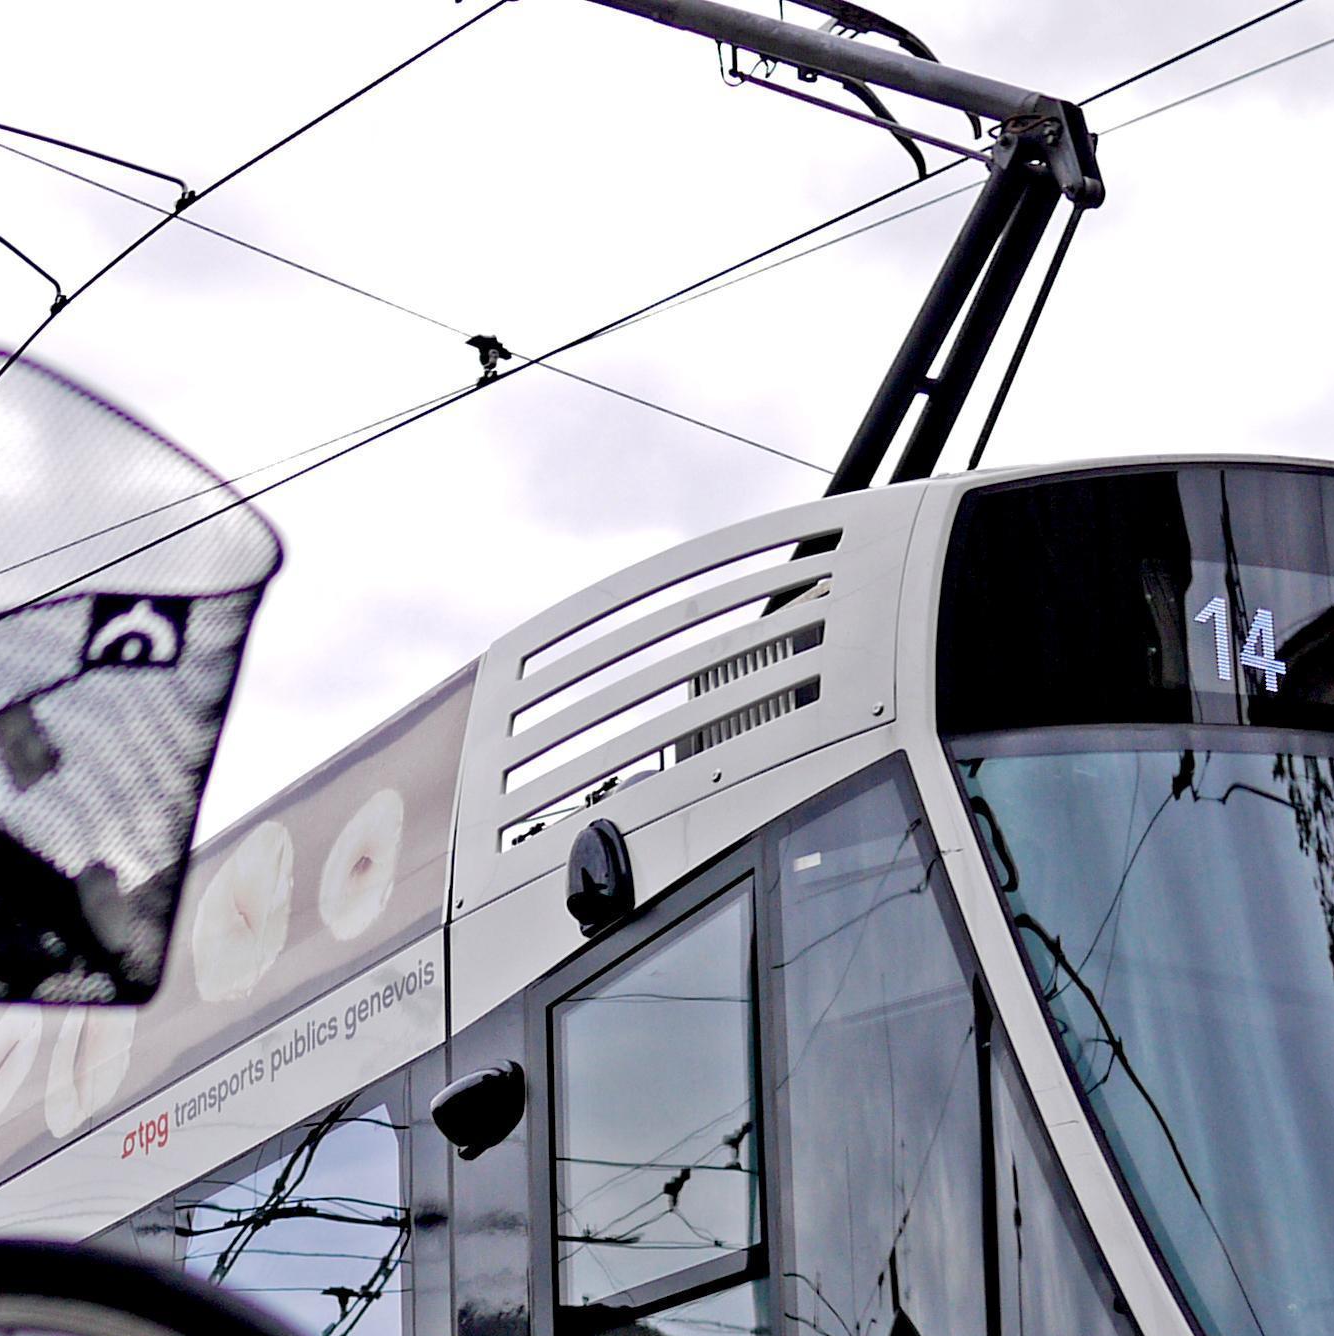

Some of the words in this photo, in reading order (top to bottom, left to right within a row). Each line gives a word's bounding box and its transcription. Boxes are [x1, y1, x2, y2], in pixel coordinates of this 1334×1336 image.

[1193, 596, 1287, 692] 14
[174, 1058, 265, 1129] transports
[270, 1013, 338, 1083] publics
[344, 960, 436, 1041] genevois
